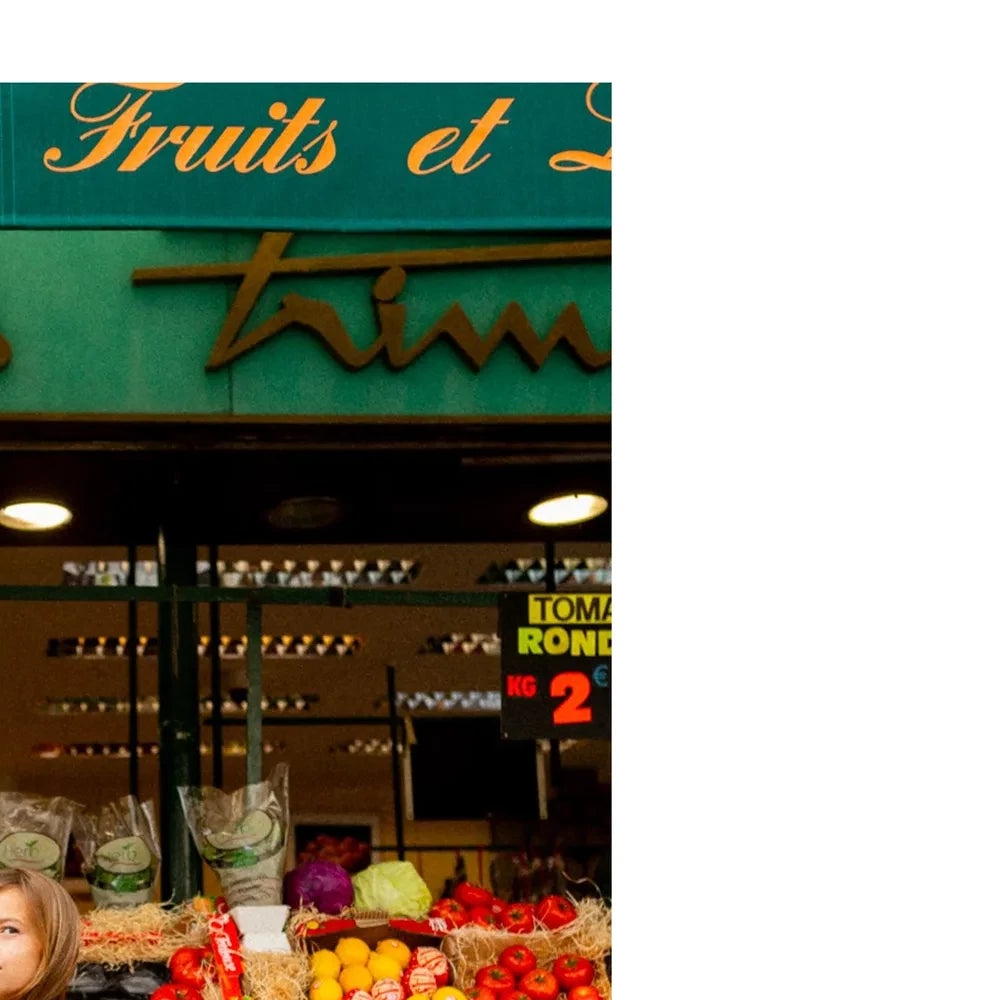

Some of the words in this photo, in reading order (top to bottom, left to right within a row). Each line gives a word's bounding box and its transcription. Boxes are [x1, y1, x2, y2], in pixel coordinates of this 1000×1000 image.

[42, 82, 337, 176] Fruits
[406, 97, 515, 176] et
[506, 675, 537, 698] KG
[549, 671, 592, 726] 2
